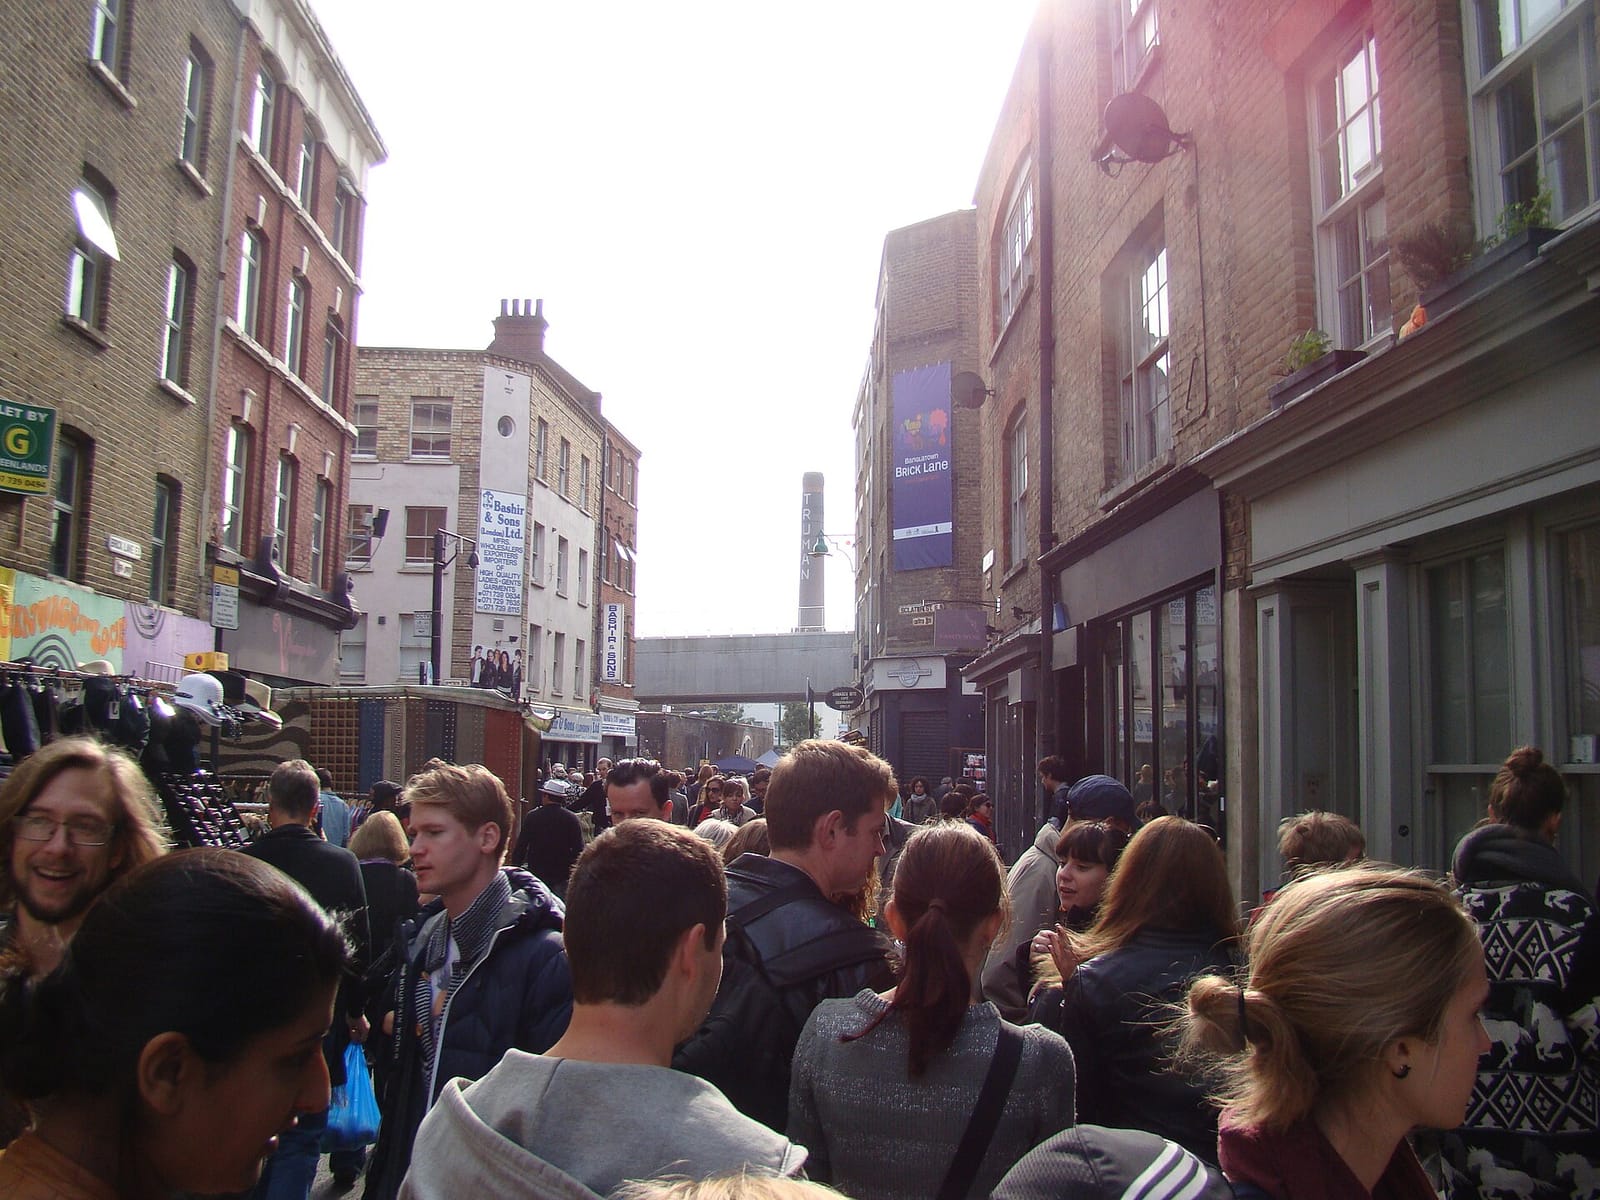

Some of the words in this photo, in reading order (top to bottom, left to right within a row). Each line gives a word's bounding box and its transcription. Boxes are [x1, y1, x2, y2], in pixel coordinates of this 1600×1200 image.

[0, 404, 24, 418] LET
[26, 410, 49, 422] BY
[6, 428, 30, 454] G
[923, 460, 949, 473] Lane
[494, 500, 525, 515] Bashir
[484, 511, 493, 523] &
[497, 513, 521, 527] Sons
[505, 526, 524, 540] Ltd.
[801, 493, 811, 580] TRUMAN
[480, 542, 524, 554] WHOLESALERS
[483, 549, 520, 560] EXPORTERS
[483, 556, 518, 567] IMPORTERS
[479, 569, 494, 577] HIGH
[496, 571, 522, 580] QUALITY
[483, 583, 516, 593] GARMENTS
[608, 605, 617, 642] BASHIR
[607, 652, 616, 678] SONS
